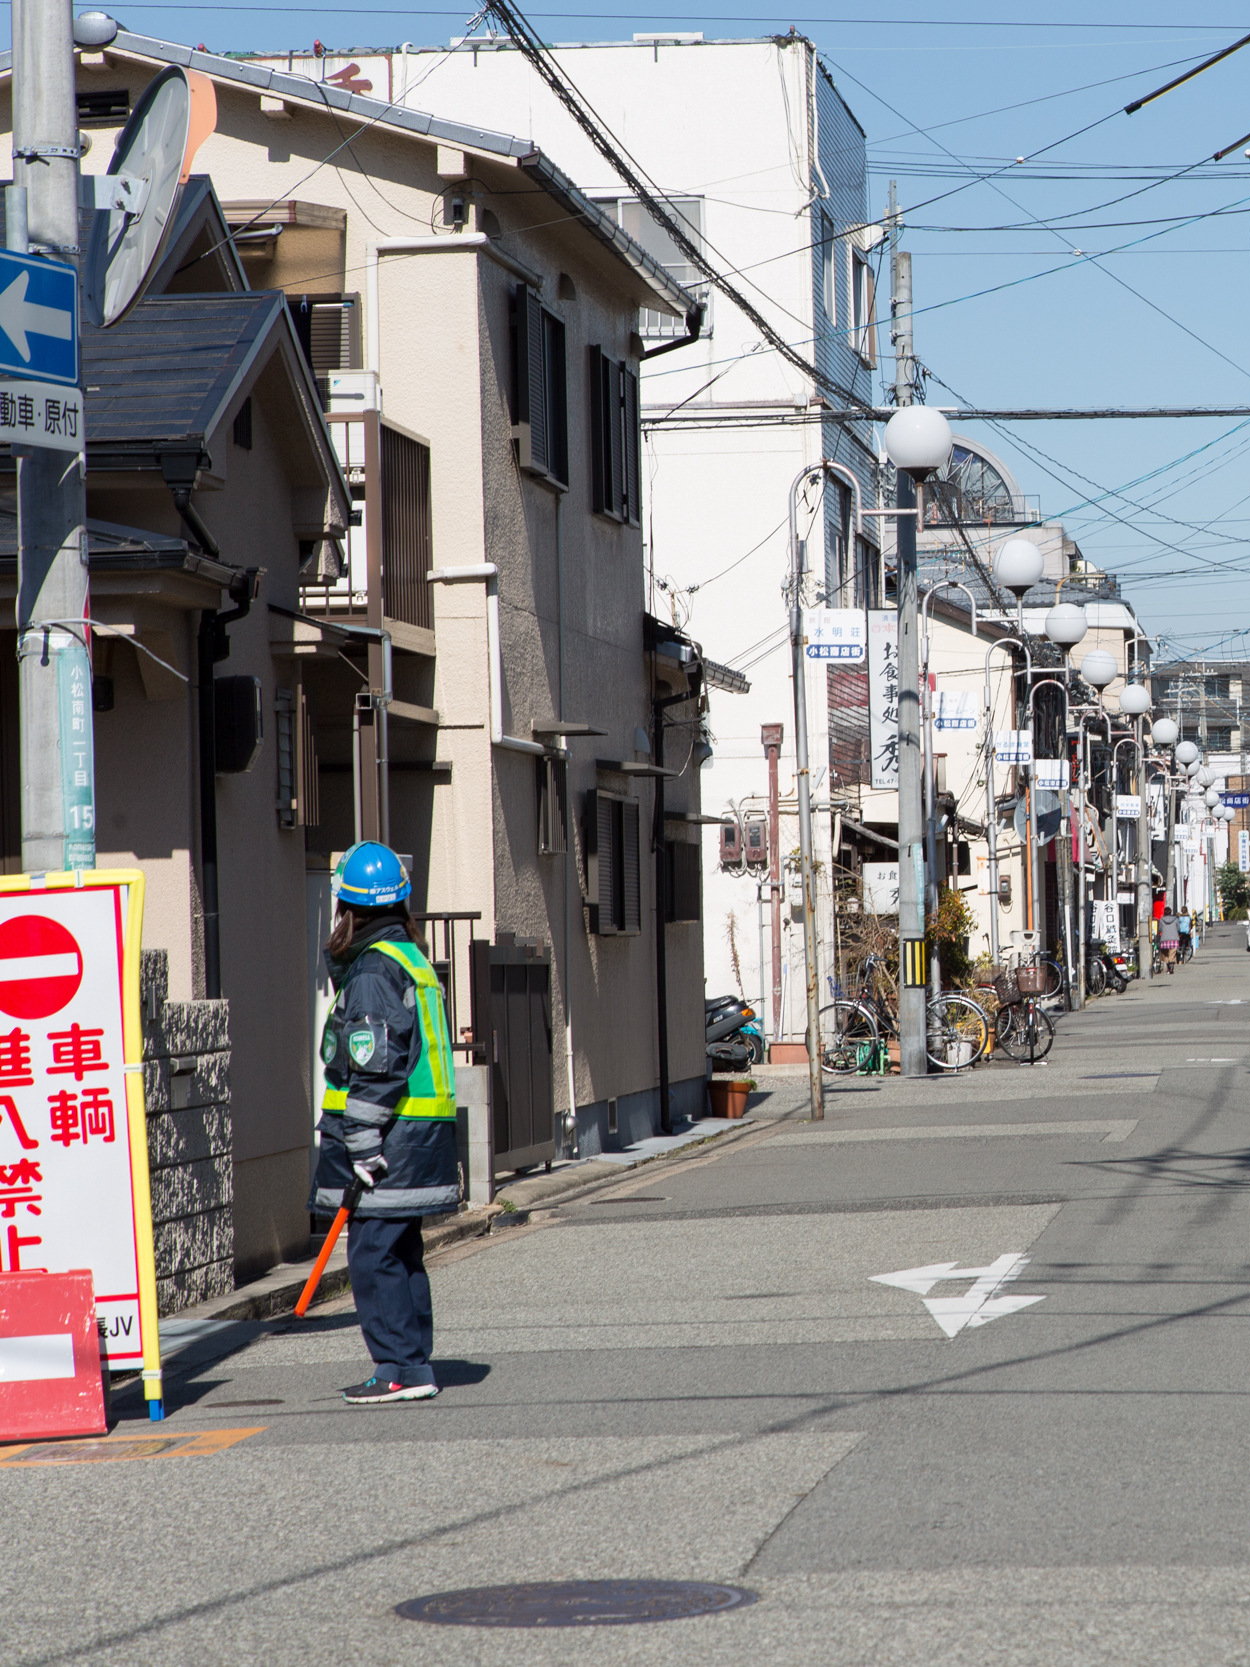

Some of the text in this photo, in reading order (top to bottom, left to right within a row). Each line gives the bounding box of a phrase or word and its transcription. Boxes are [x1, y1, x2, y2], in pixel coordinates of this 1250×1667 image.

[814, 627, 861, 637] 水明荘
[809, 646, 861, 657] 小松商店街
[70, 665, 87, 786] 小松南町一丁目
[69, 806, 93, 829] 15
